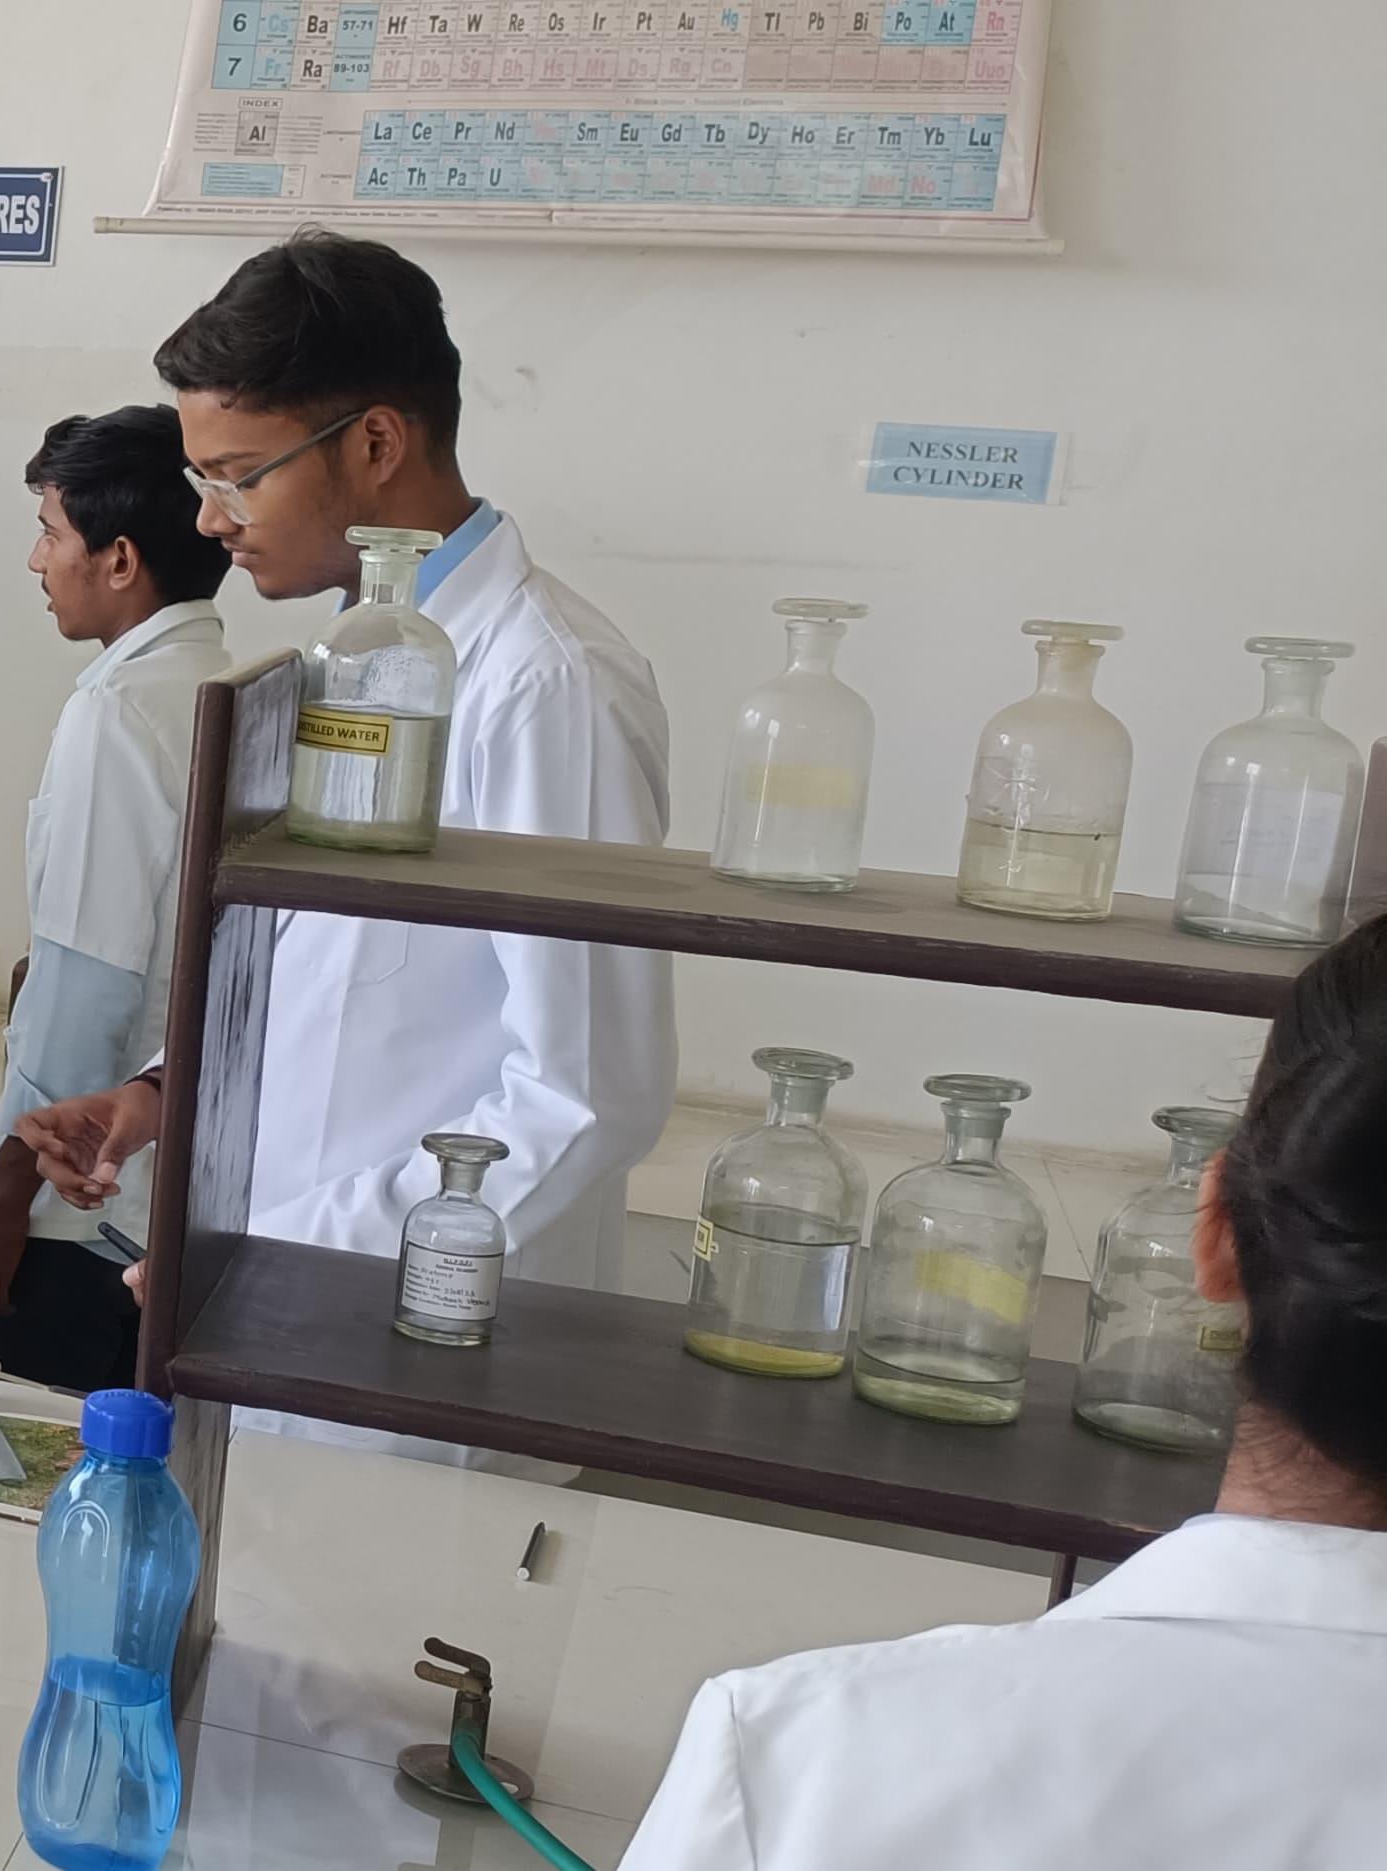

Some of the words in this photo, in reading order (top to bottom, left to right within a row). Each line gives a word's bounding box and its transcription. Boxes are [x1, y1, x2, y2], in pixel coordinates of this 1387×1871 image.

[233, 13, 247, 32] 6
[307, 15, 328, 33] Ba
[342, 20, 373, 31] 57-71
[388, 16, 407, 34] Hf
[429, 15, 448, 33] Ta
[466, 14, 483, 32] W
[508, 14, 525, 32] Re
[548, 12, 565, 31] Os
[593, 12, 607, 31] Ir
[636, 12, 652, 31] Pt
[677, 12, 695, 31] Au
[721, 8, 739, 32] Hg
[764, 13, 780, 31] Tl
[808, 12, 824, 31] Pb
[853, 12, 869, 31] Bi
[894, 12, 912, 31] Po
[938, 13, 955, 31] At
[986, 12, 1005, 31] Rn
[228, 57, 242, 76] 7
[302, 59, 323, 78] Ra
[333, 63, 370, 73] 89-103
[242, 99, 279, 108] INDEX
[249, 126, 266, 142] Al
[373, 123, 393, 141] La
[411, 122, 432, 140] Ce
[454, 122, 472, 140] Pr
[494, 122, 515, 141] Nd
[577, 123, 598, 142] Sm
[620, 123, 639, 142] Eu
[661, 123, 682, 142] Gd
[704, 125, 725, 143] Tb
[747, 122, 771, 145] Dy
[791, 126, 815, 144] Ho
[836, 126, 855, 145] Er
[878, 126, 902, 145] Tm
[924, 127, 945, 146] Yb
[968, 128, 991, 146] Lu
[368, 168, 388, 186] Ac
[407, 168, 426, 186] Th
[448, 168, 466, 186] Pa
[489, 168, 501, 186] U
[907, 441, 1018, 464] NESSLER
[893, 465, 1024, 490] CYLINDER
[337, 726, 380, 742] WATER
